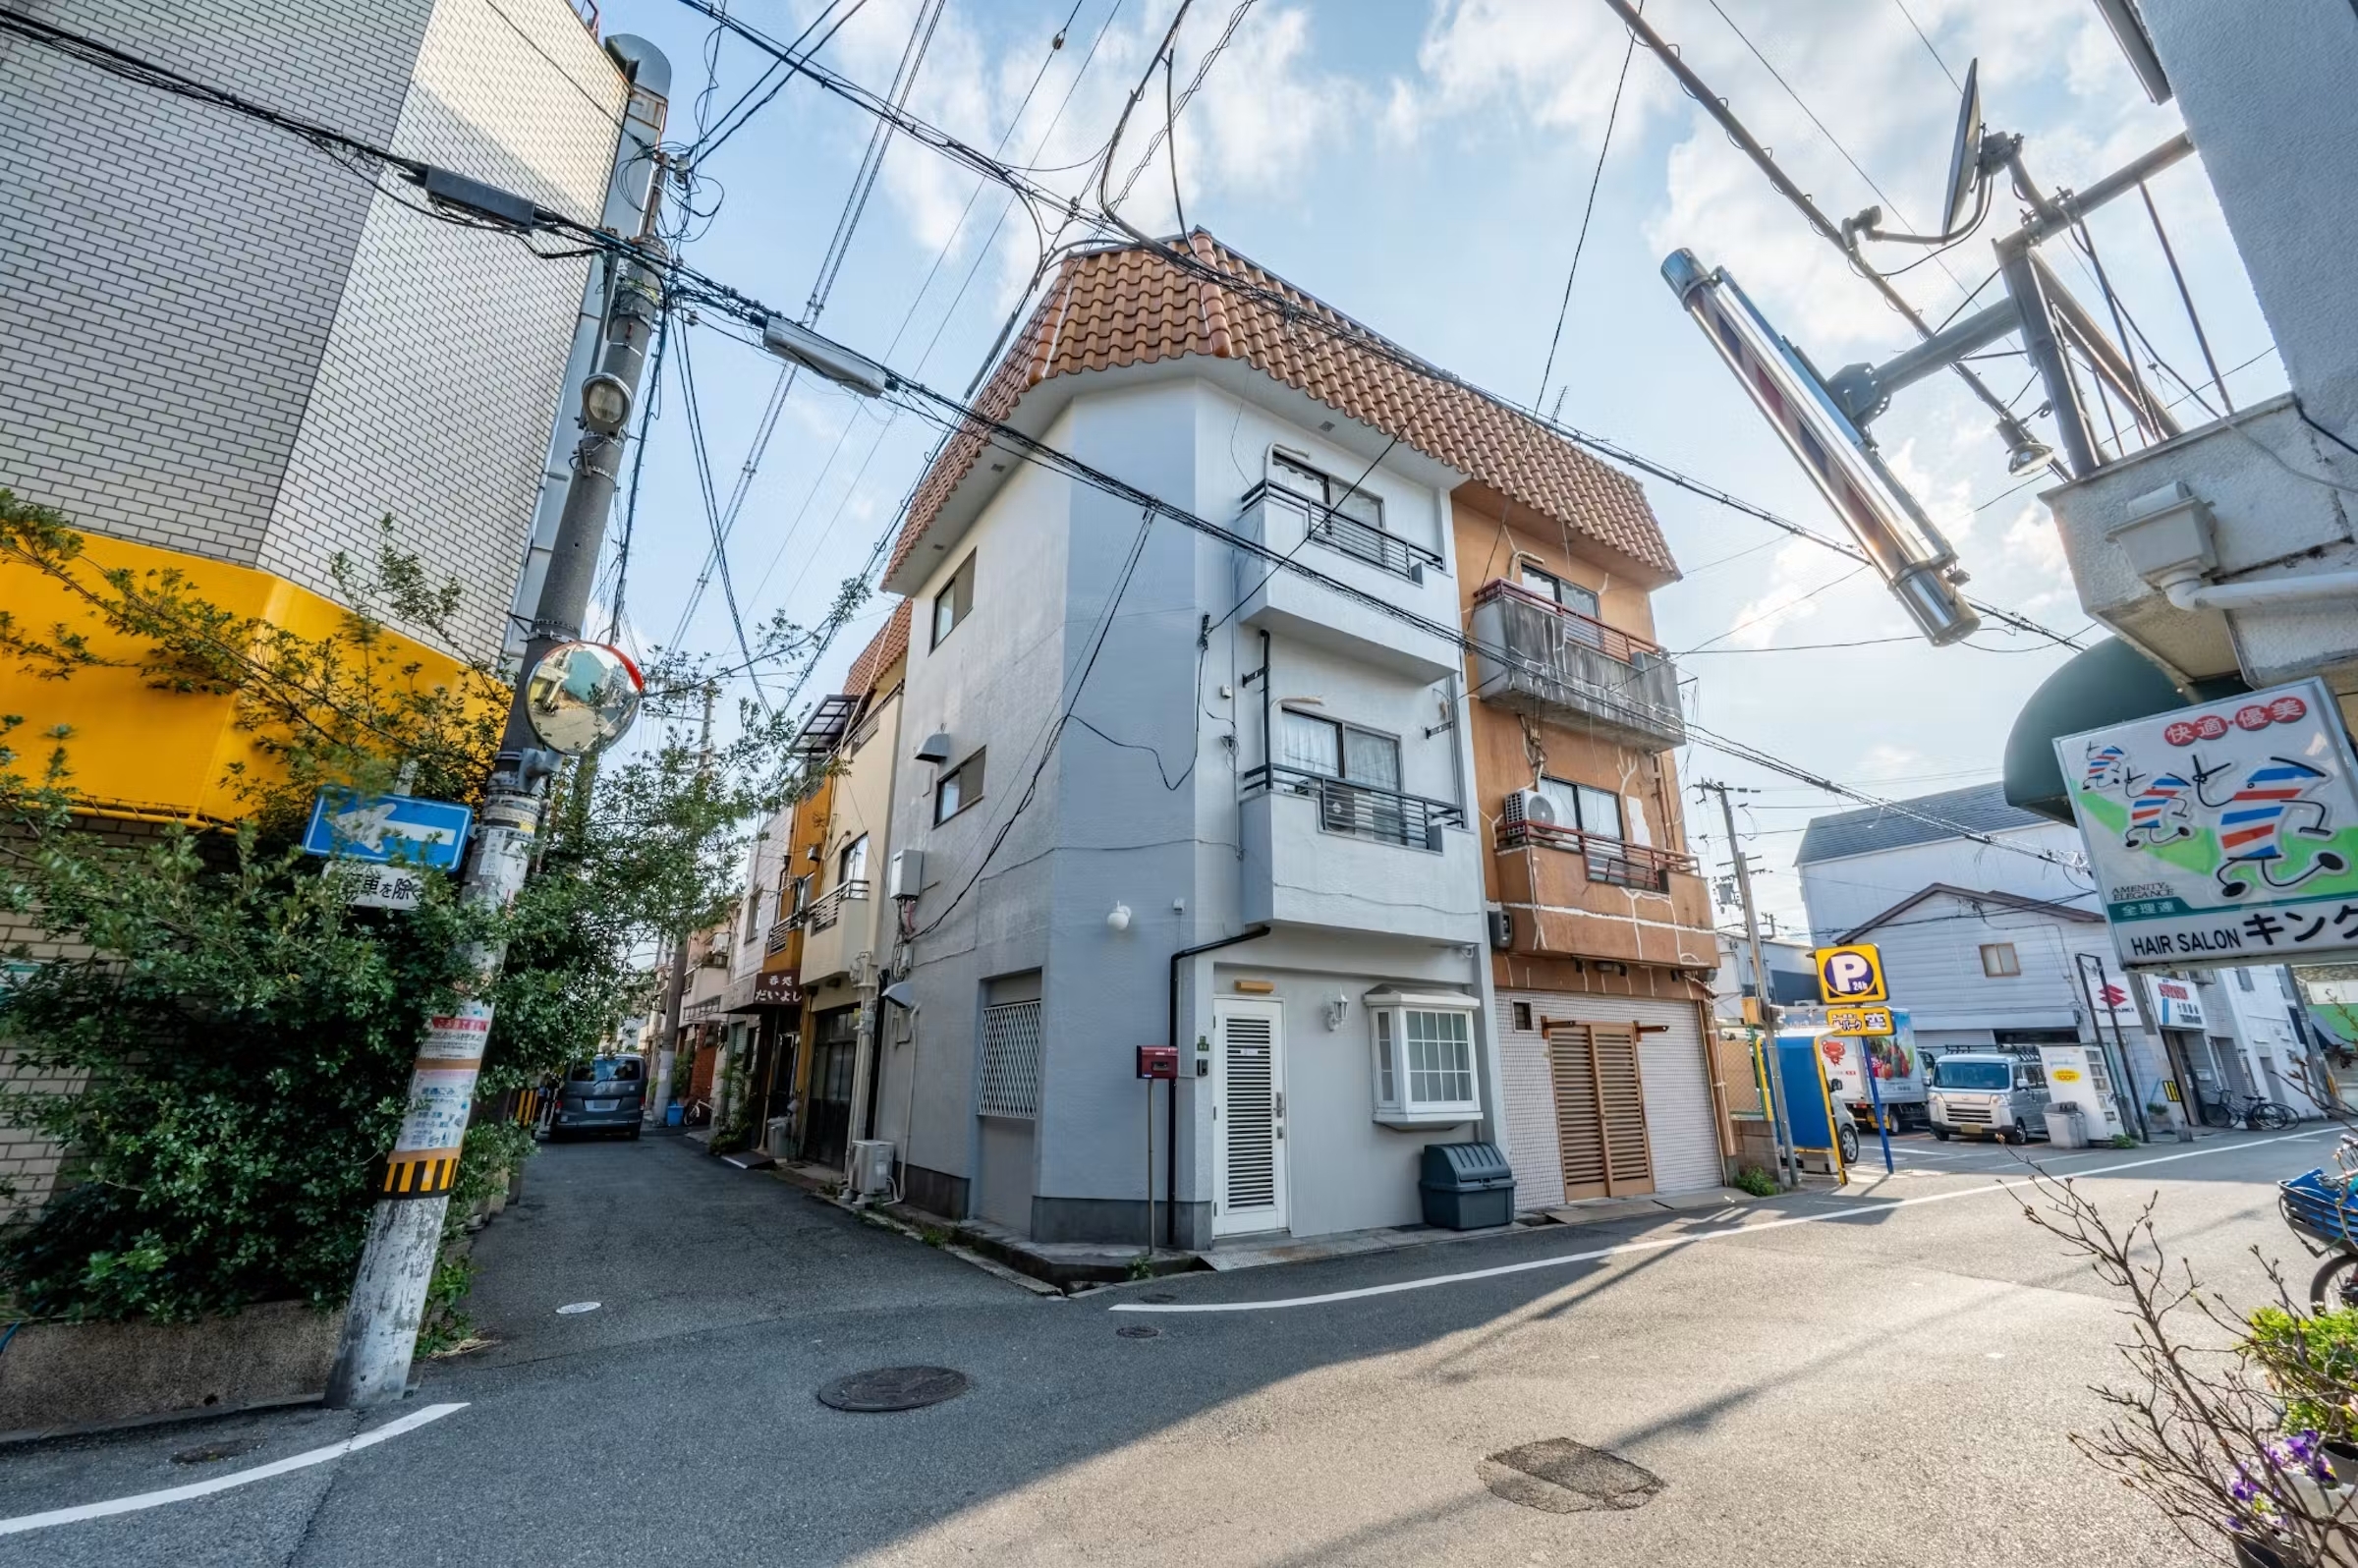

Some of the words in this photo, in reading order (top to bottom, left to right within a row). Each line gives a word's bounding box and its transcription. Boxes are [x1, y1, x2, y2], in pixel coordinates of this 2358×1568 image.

[2166, 699, 2304, 744] 快適・優美
[2111, 881, 2165, 895] AMENITY
[2113, 888, 2174, 902] ELEGANCE
[2122, 901, 2175, 917] 全理連
[2130, 935, 2174, 957] HAIR
[2176, 927, 2242, 953] SALON
[1830, 954, 1868, 992] P
[1852, 980, 1869, 991] 24h
[755, 989, 803, 1002] だいよし
